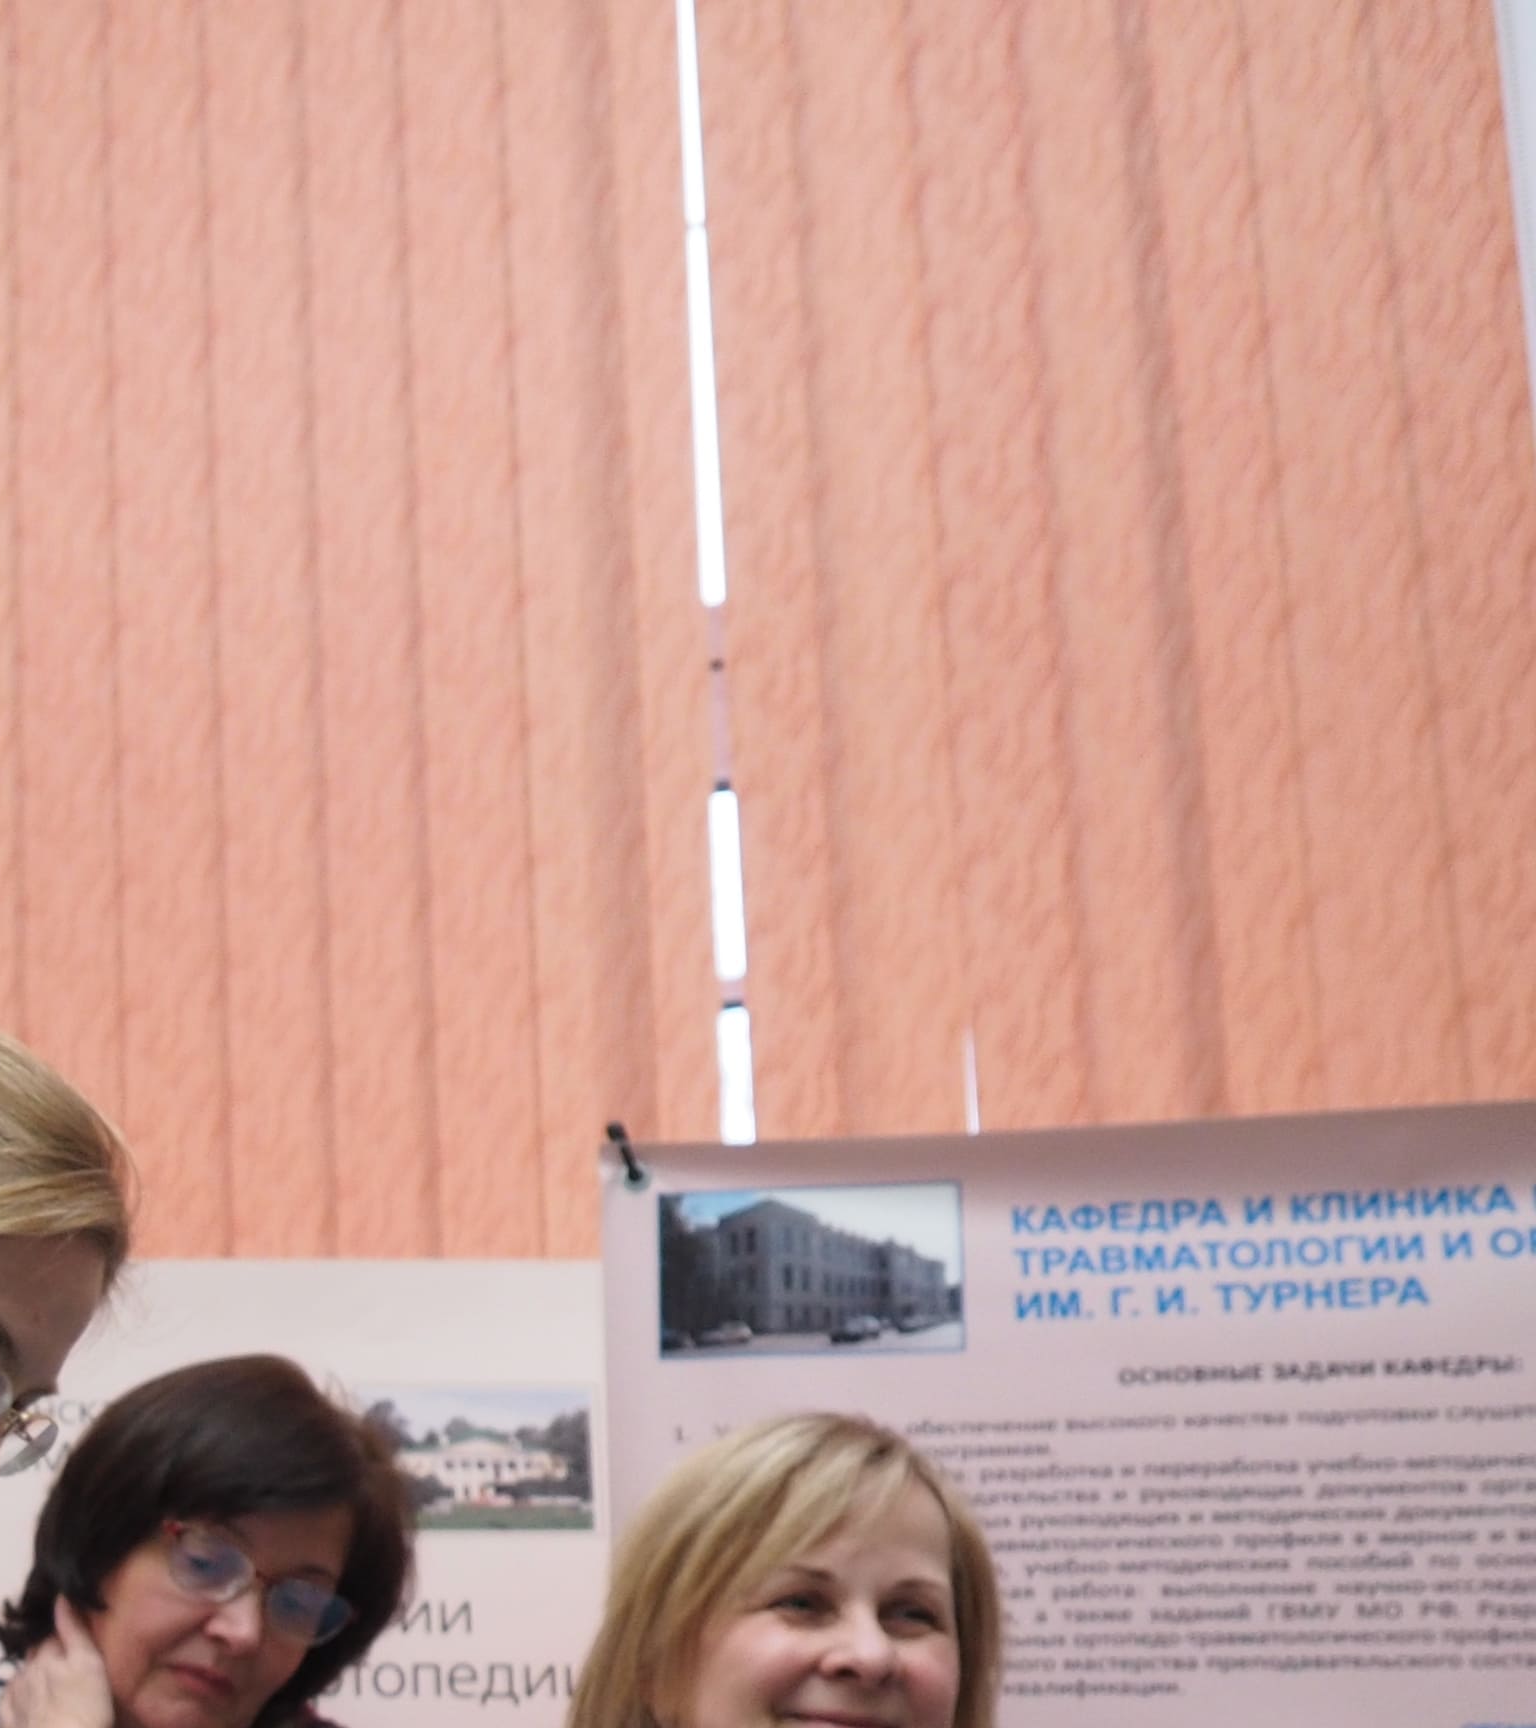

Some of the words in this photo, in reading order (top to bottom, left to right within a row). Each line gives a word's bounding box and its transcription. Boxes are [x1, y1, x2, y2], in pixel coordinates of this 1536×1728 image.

[1011, 1197, 1228, 1234] КАФЕДРА
[1243, 1195, 1273, 1226] И
[1290, 1184, 1517, 1224] КЛИНИКА
[1014, 1233, 1425, 1277] ТРАВМАТОЛОГИИ
[1441, 1230, 1473, 1260] И
[1015, 1289, 1095, 1321] ИМ.
[1110, 1286, 1141, 1318] Г.
[1156, 1285, 1200, 1316] И.
[1213, 1275, 1431, 1314] ТУРНЕРА
[1117, 1362, 1263, 1387] ОСНОВНЫЕ
[1272, 1359, 1377, 1383] ЗАДАЧИ
[324, 1650, 580, 1706] топеди
